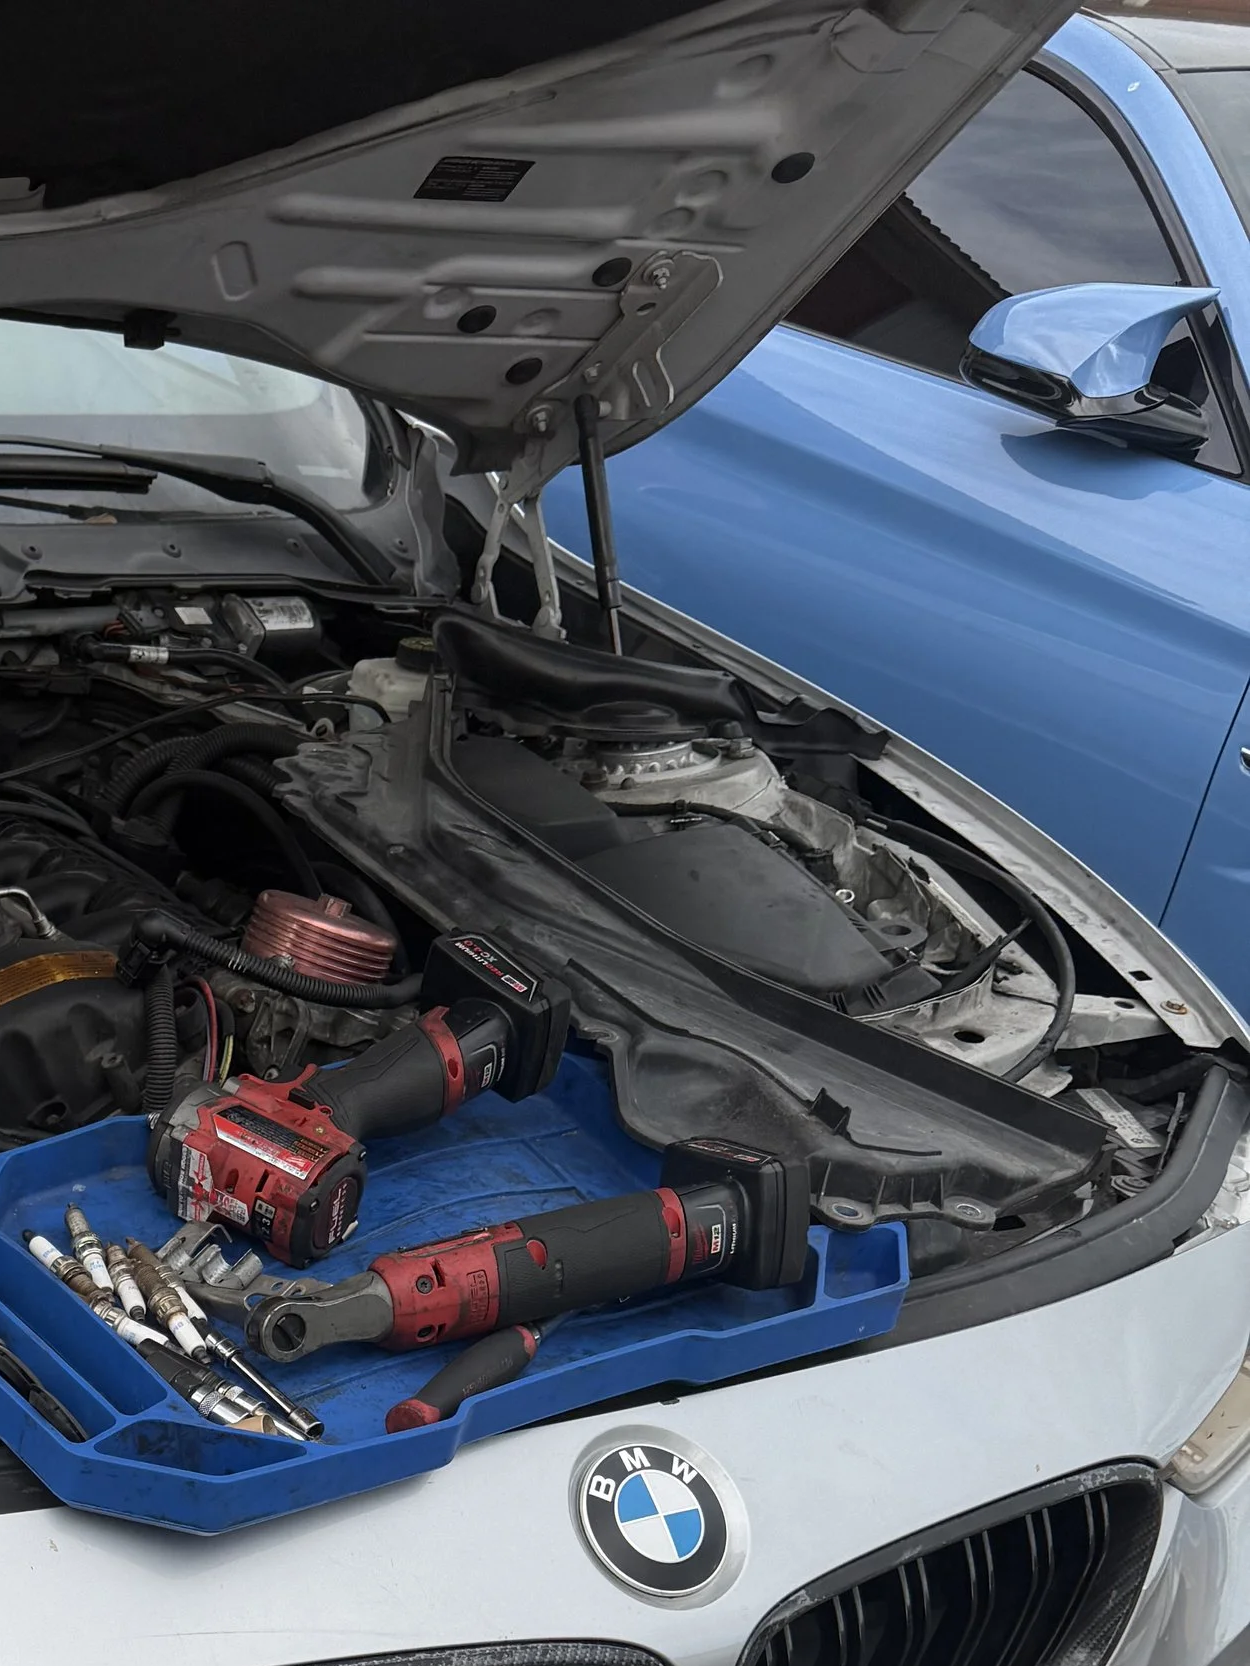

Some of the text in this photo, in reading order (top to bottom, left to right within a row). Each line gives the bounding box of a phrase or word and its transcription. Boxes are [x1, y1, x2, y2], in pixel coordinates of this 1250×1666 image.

[328, 1188, 342, 1244] FUEL
[712, 1225, 720, 1252] M12
[588, 1447, 698, 1502] BMW
